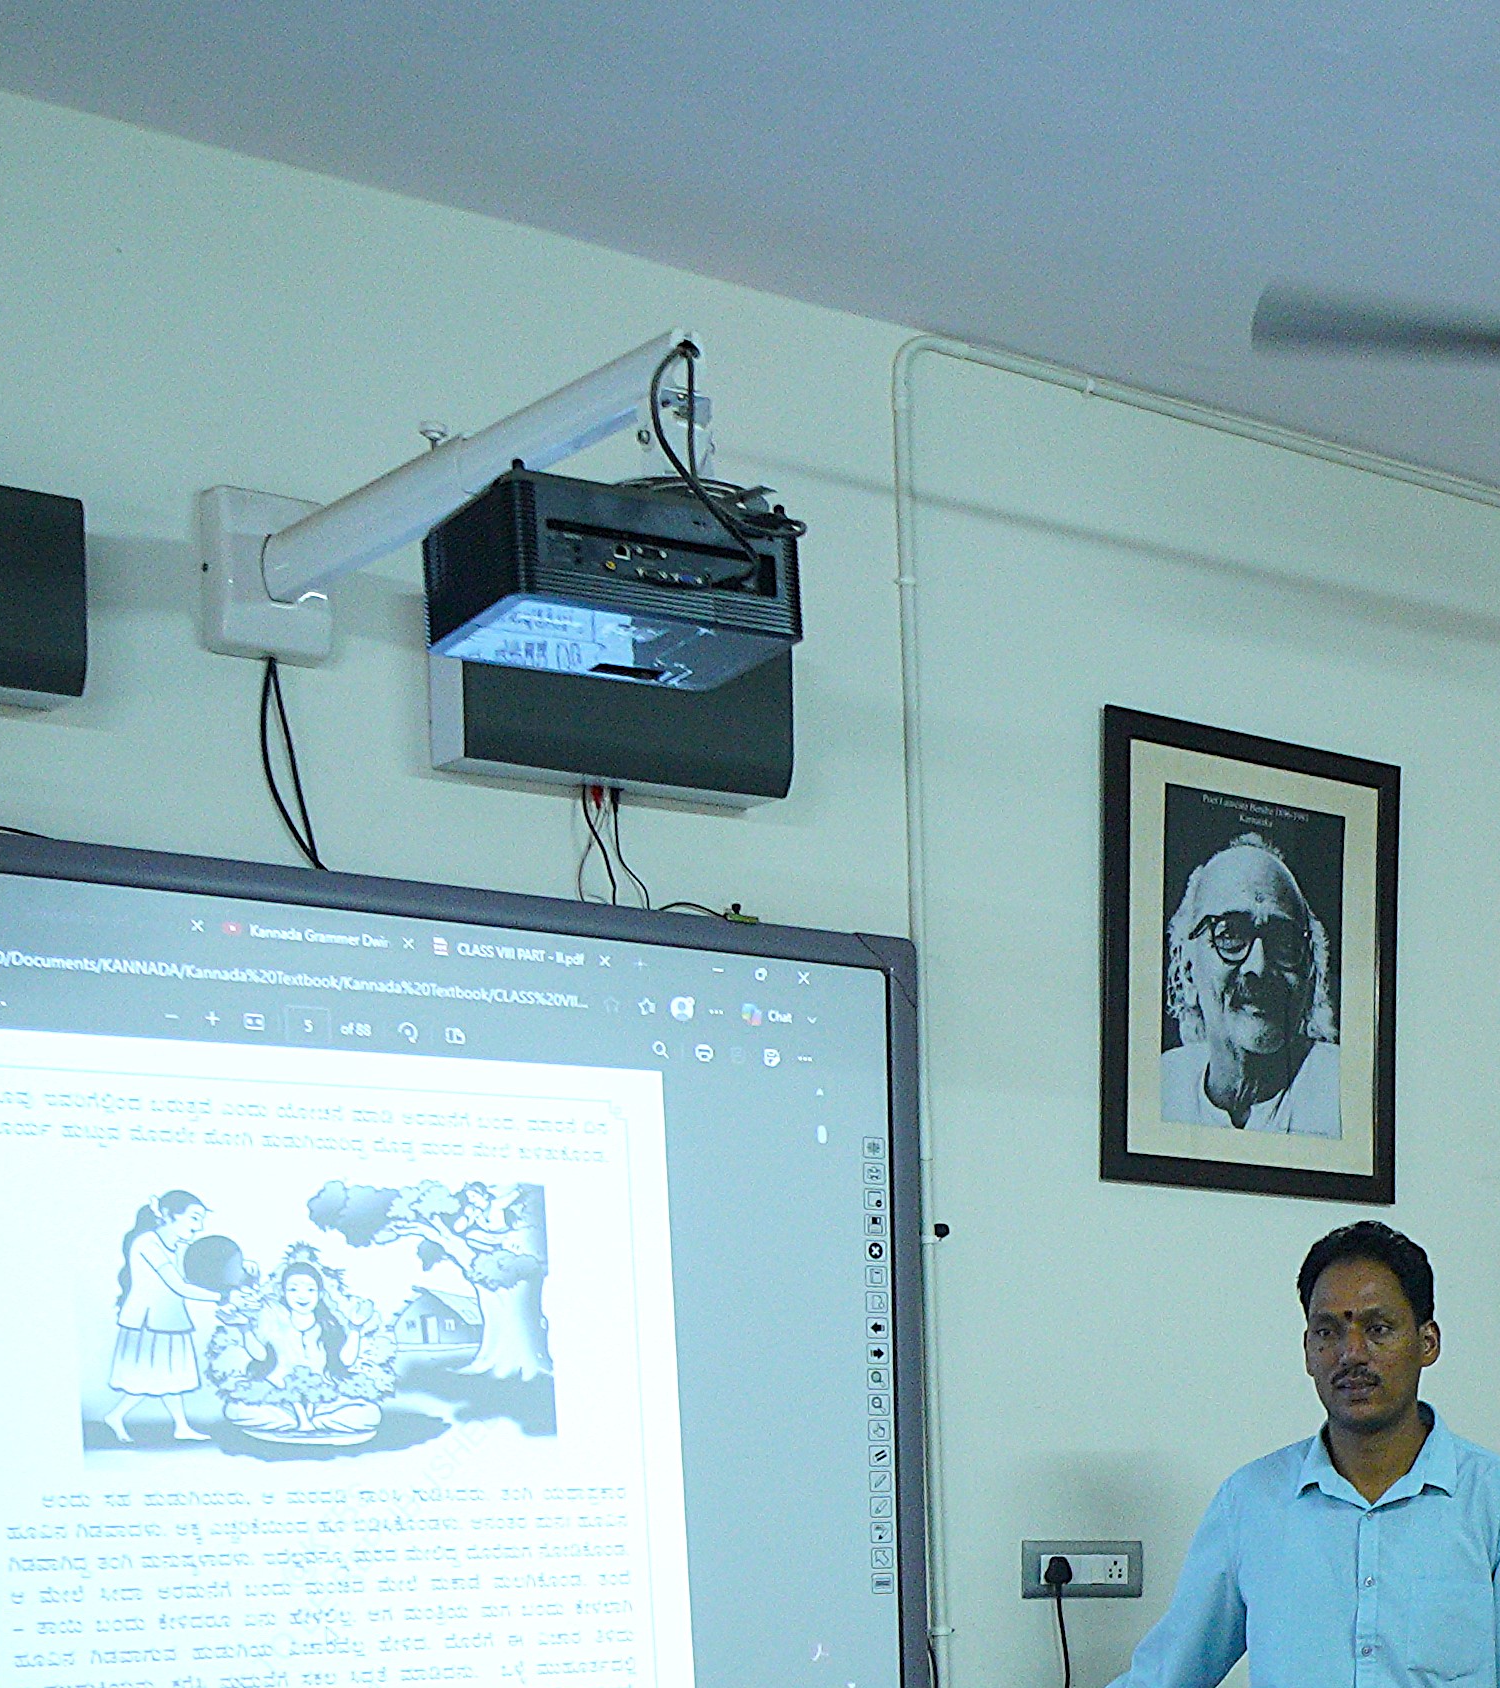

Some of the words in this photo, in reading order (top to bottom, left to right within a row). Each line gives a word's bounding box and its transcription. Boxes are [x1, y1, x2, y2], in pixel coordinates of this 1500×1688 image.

[249, 923, 302, 943] Kannada
[304, 929, 360, 948] Grammer
[456, 941, 495, 960] CLASS
[517, 948, 547, 964] PART
[767, 1008, 794, 1025] Chat
[303, 1018, 314, 1034] 5
[340, 1022, 356, 1037] of
